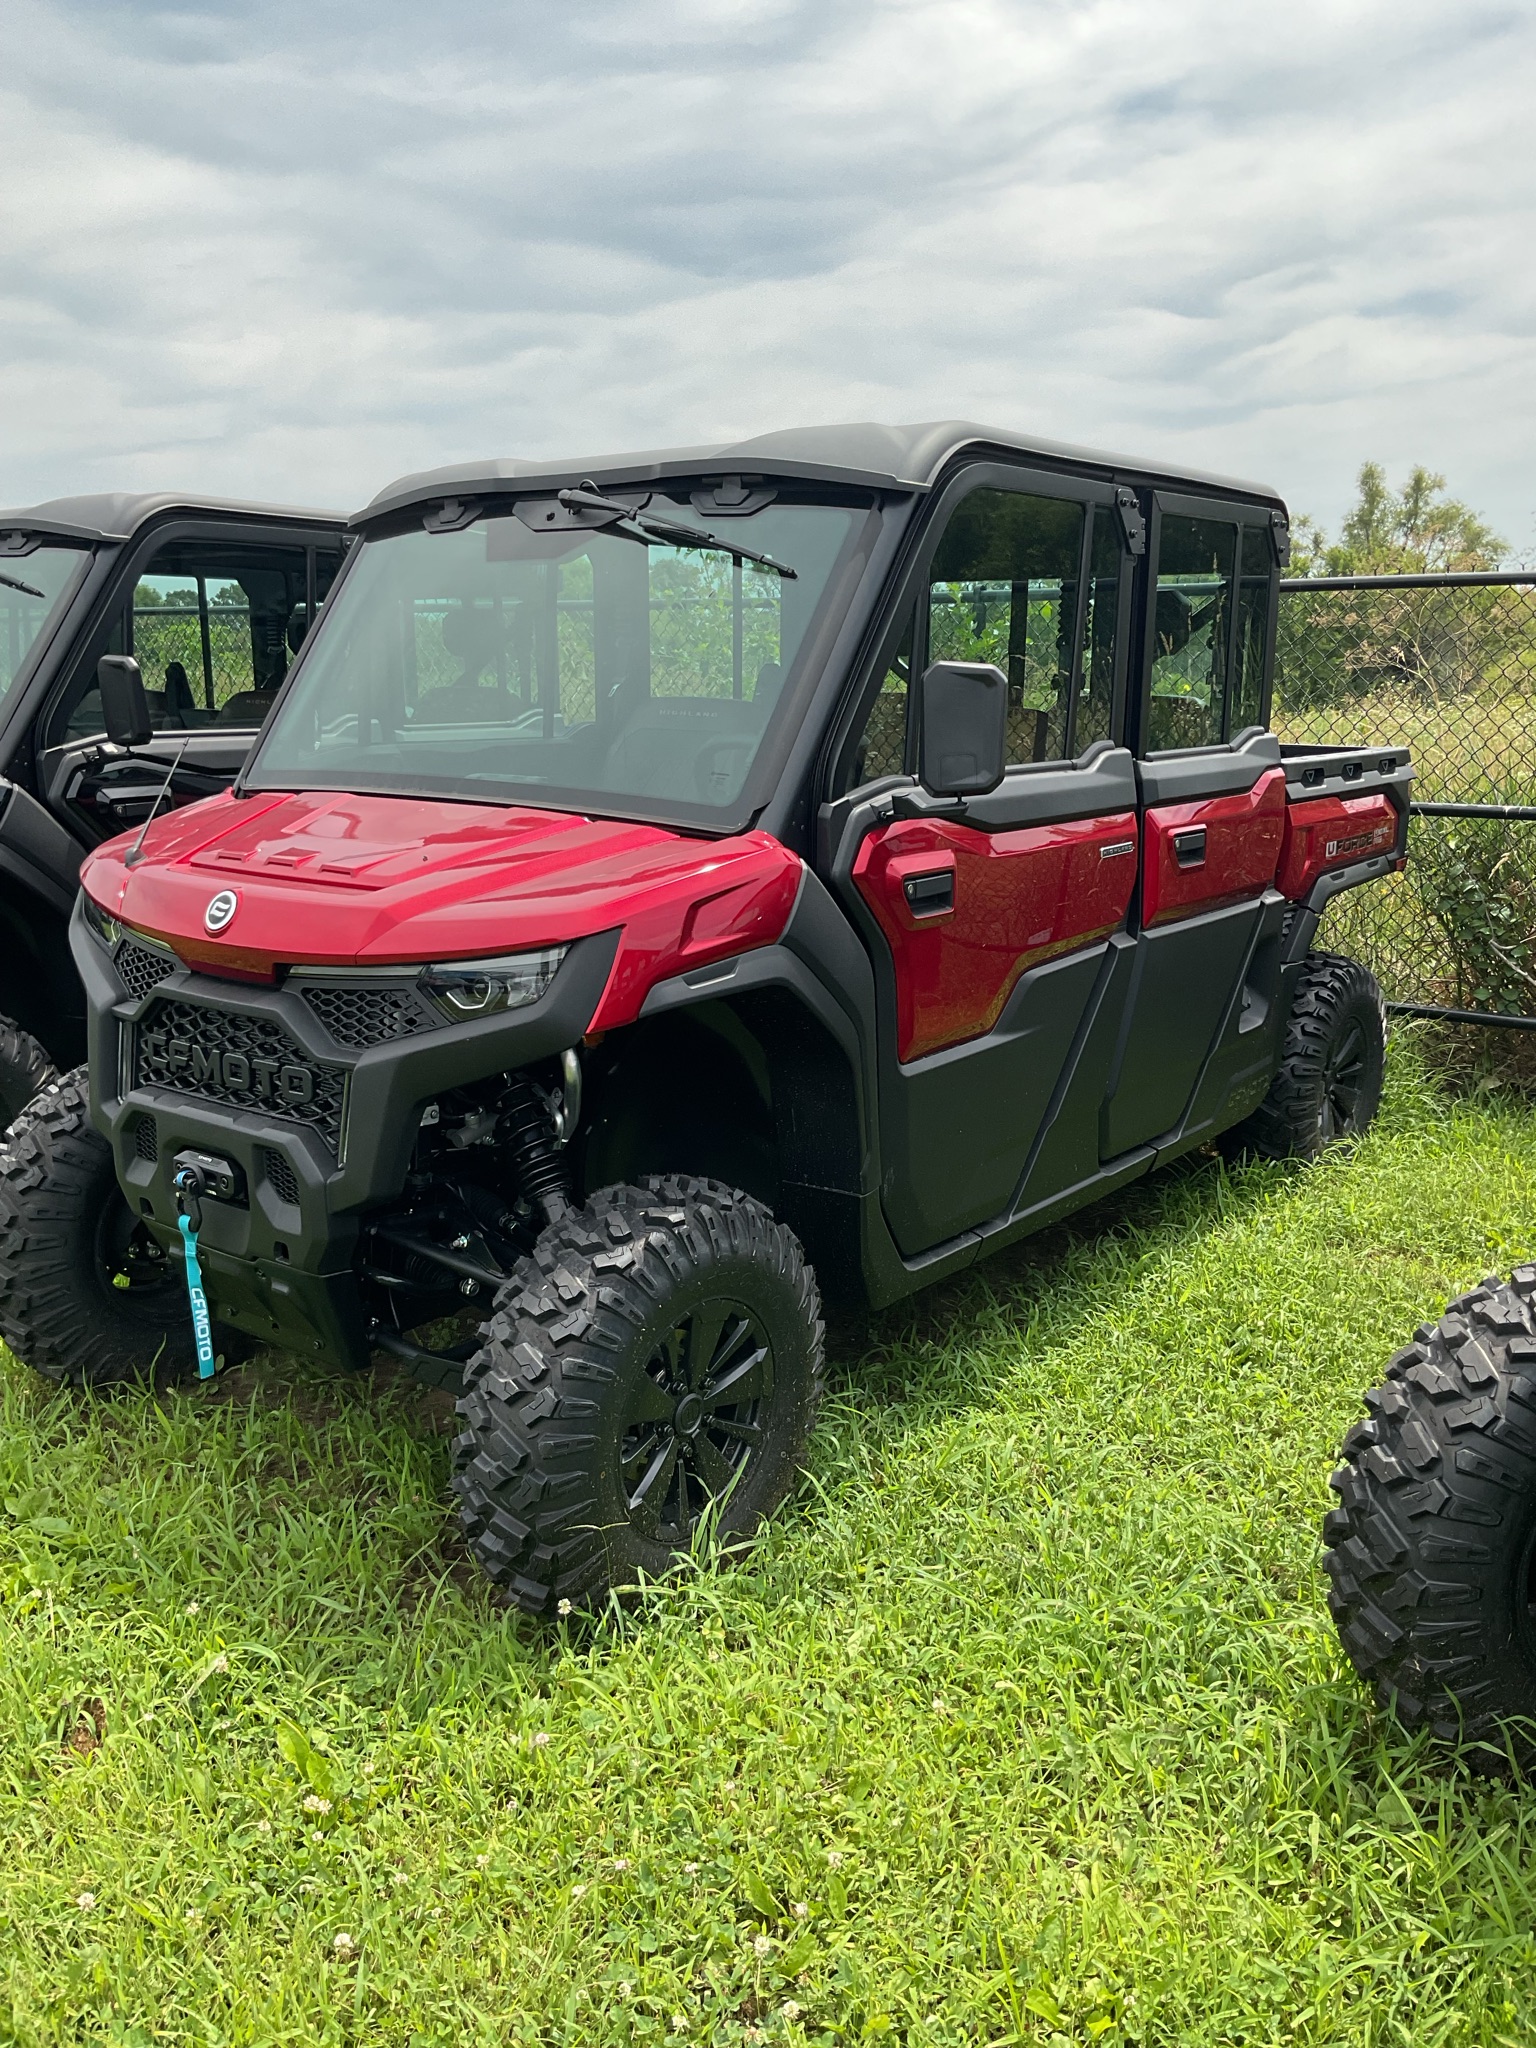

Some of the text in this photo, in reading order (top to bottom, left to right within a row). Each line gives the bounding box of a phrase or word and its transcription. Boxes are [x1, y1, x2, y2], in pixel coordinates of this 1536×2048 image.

[659, 708, 718, 718] HIGHLAND
[147, 1033, 313, 1103] CFMOTO
[191, 1287, 212, 1361] CFMOTO
